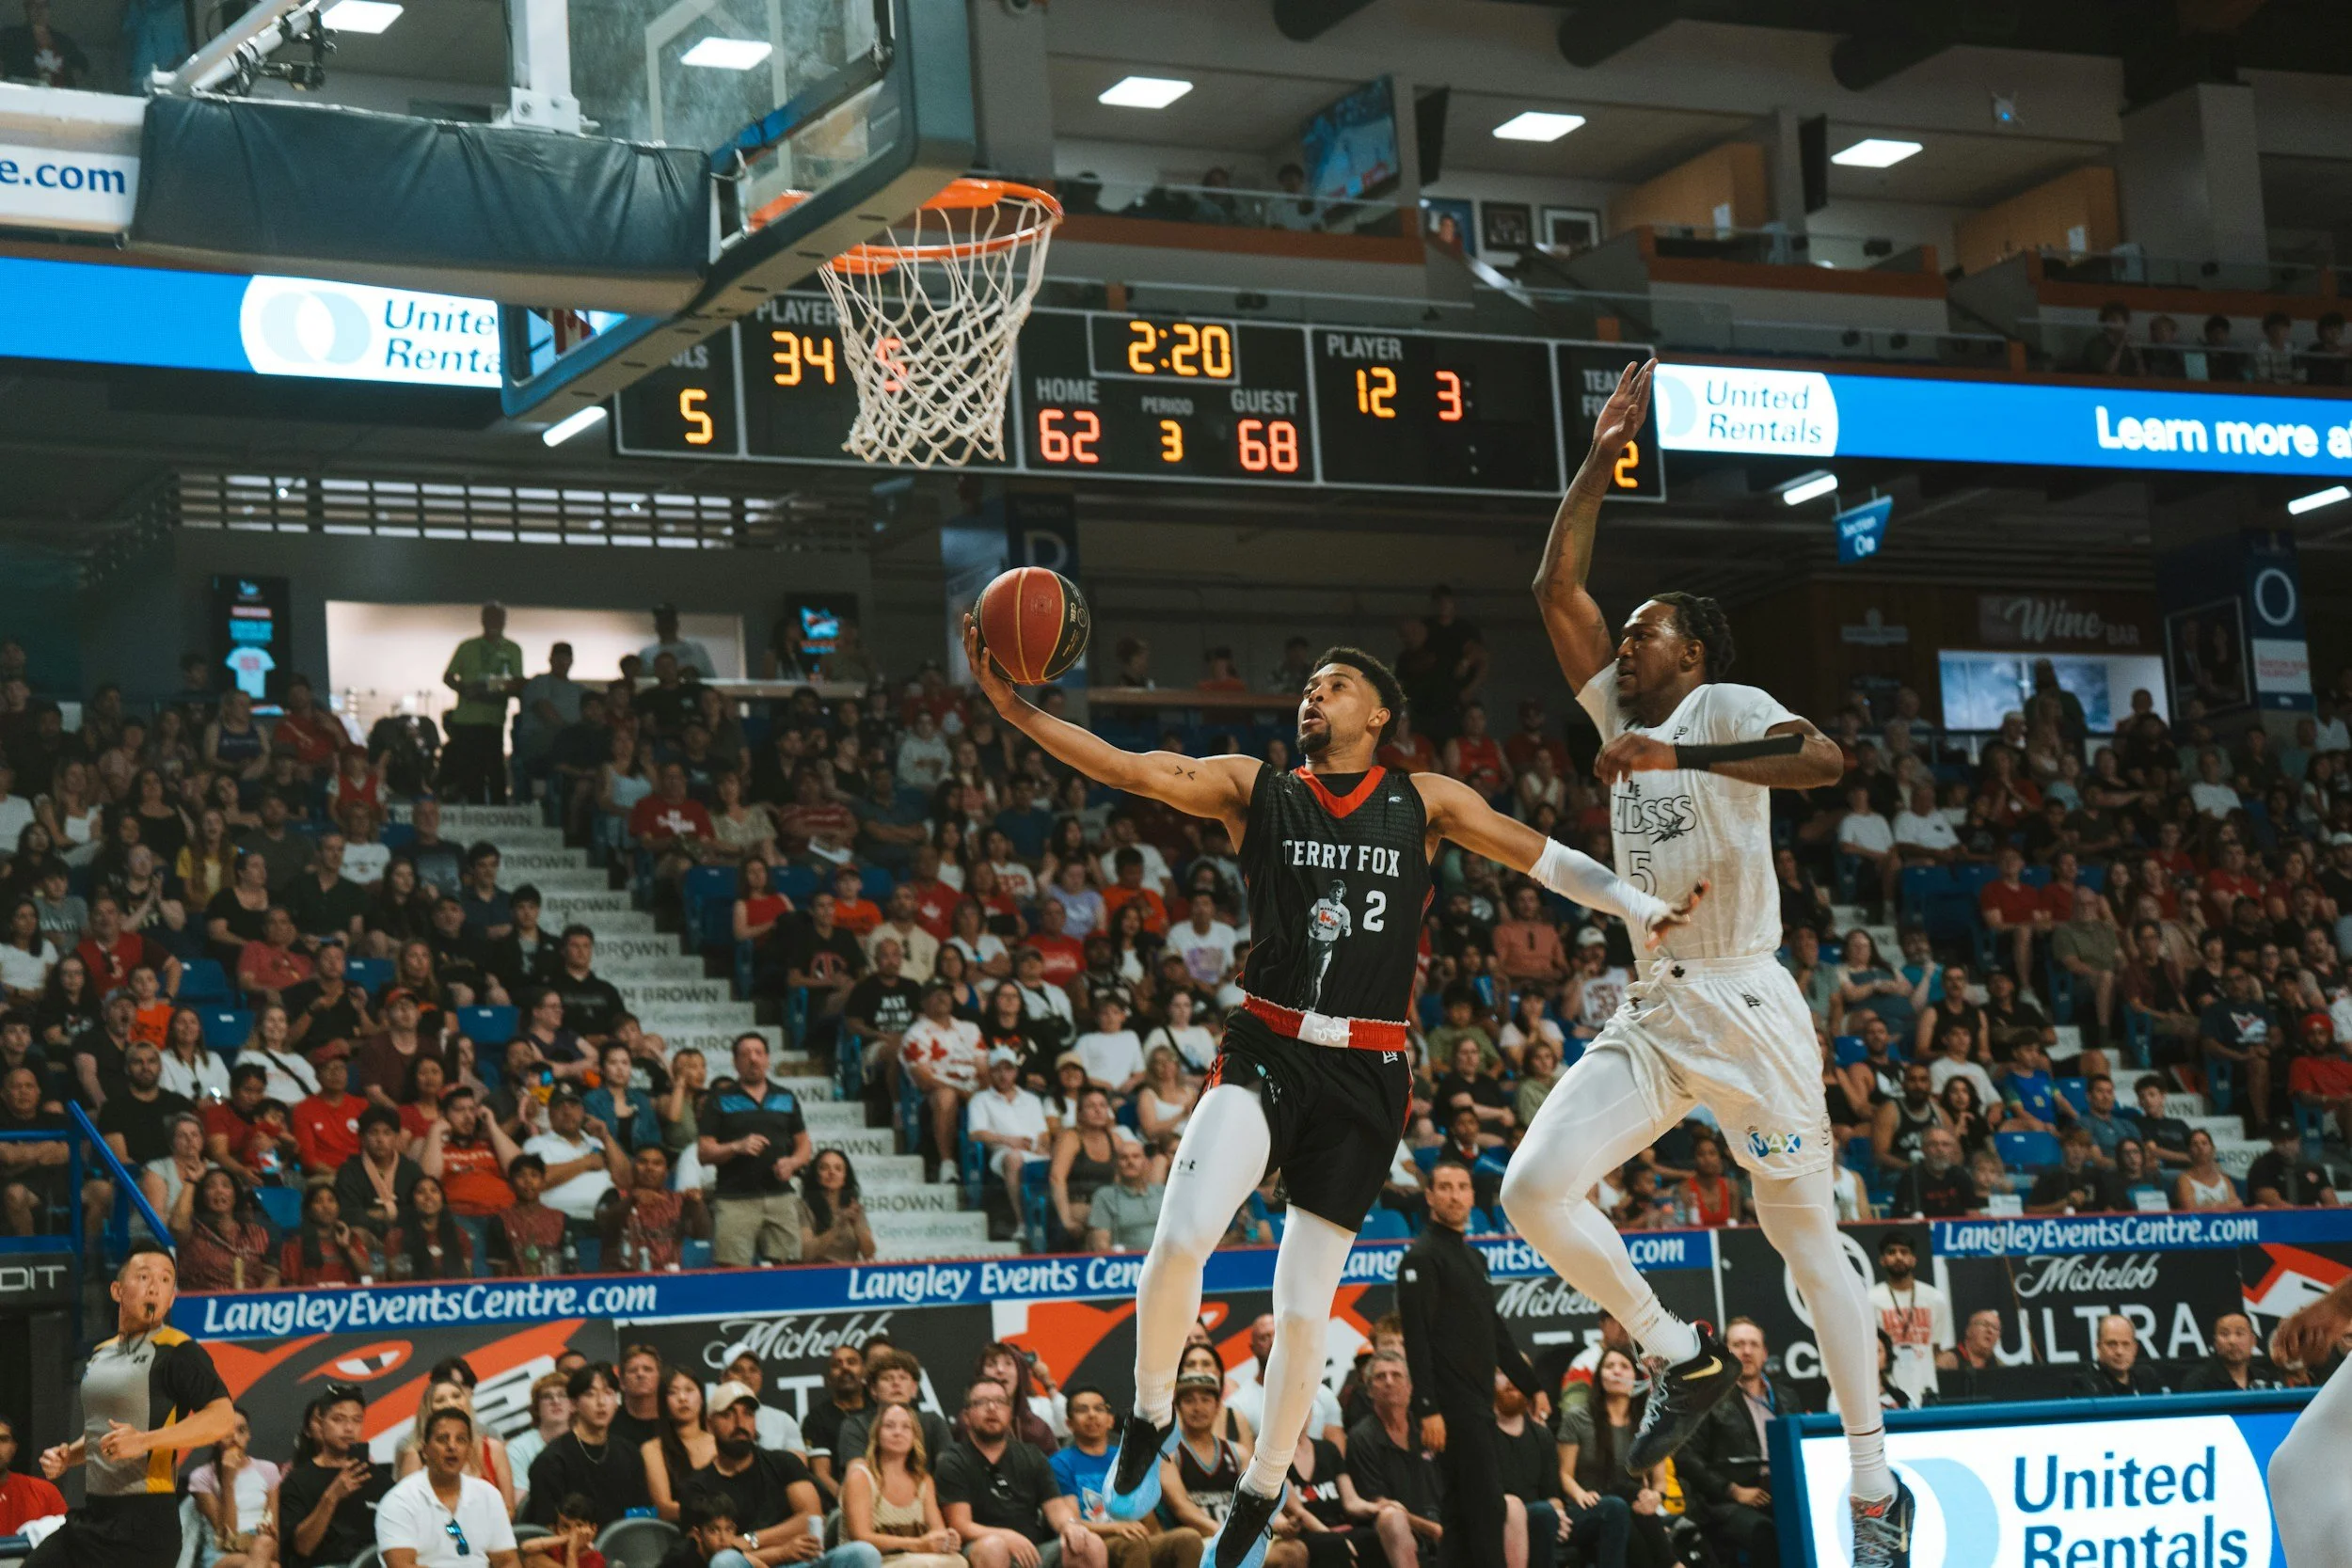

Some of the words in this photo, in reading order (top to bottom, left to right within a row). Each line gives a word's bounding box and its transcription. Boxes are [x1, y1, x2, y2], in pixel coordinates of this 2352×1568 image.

[384, 298, 496, 335] Unite
[756, 299, 840, 325] PLAYER
[384, 338, 501, 372] Renta
[670, 345, 709, 370] ULS
[771, 330, 835, 386] 34
[1128, 320, 1232, 378] 2:20
[1327, 334, 1404, 361] PLAYER
[1036, 377, 1100, 404] HOME
[1140, 396, 1194, 417] PERIOD
[1231, 388, 1298, 416] GUEST
[1356, 366, 1397, 419] 12
[1435, 370, 1463, 421] 3
[1707, 381, 1809, 410] United
[678, 388, 713, 445] 5
[1038, 408, 1102, 464] 62
[1708, 413, 1821, 444] Rentals
[2095, 405, 2208, 452] Learn
[2215, 420, 2319, 458] more
[2327, 420, 2352, 459] a
[1159, 420, 1184, 463] 3
[1237, 419, 1299, 473] 68
[2005, 596, 2106, 642] Wine
[1282, 839, 1352, 870] TERRY
[1357, 845, 1401, 878] FOX
[1629, 850, 1656, 896] 5
[547, 897, 621, 912] BROWN
[1362, 889, 1387, 933] 2
[595, 941, 669, 956] BROWN
[644, 987, 719, 1003] BROWN
[694, 1037, 734, 1051] BRO
[1748, 1132, 1802, 1158] MAX
[864, 1196, 945, 1212] BROWN
[1944, 1216, 2258, 1254] LangleyEventsCentre.com
[848, 1266, 972, 1303] Langley
[980, 1259, 1077, 1295] Events
[1086, 1257, 1146, 1289] Cen
[2014, 1252, 2161, 1299] Michelob
[203, 1283, 657, 1336] LangleyEventsCentre.com
[1994, 1303, 2208, 1367] ULTRA
[2014, 1446, 2216, 1513] United
[2024, 1515, 2249, 1568] Rentals
